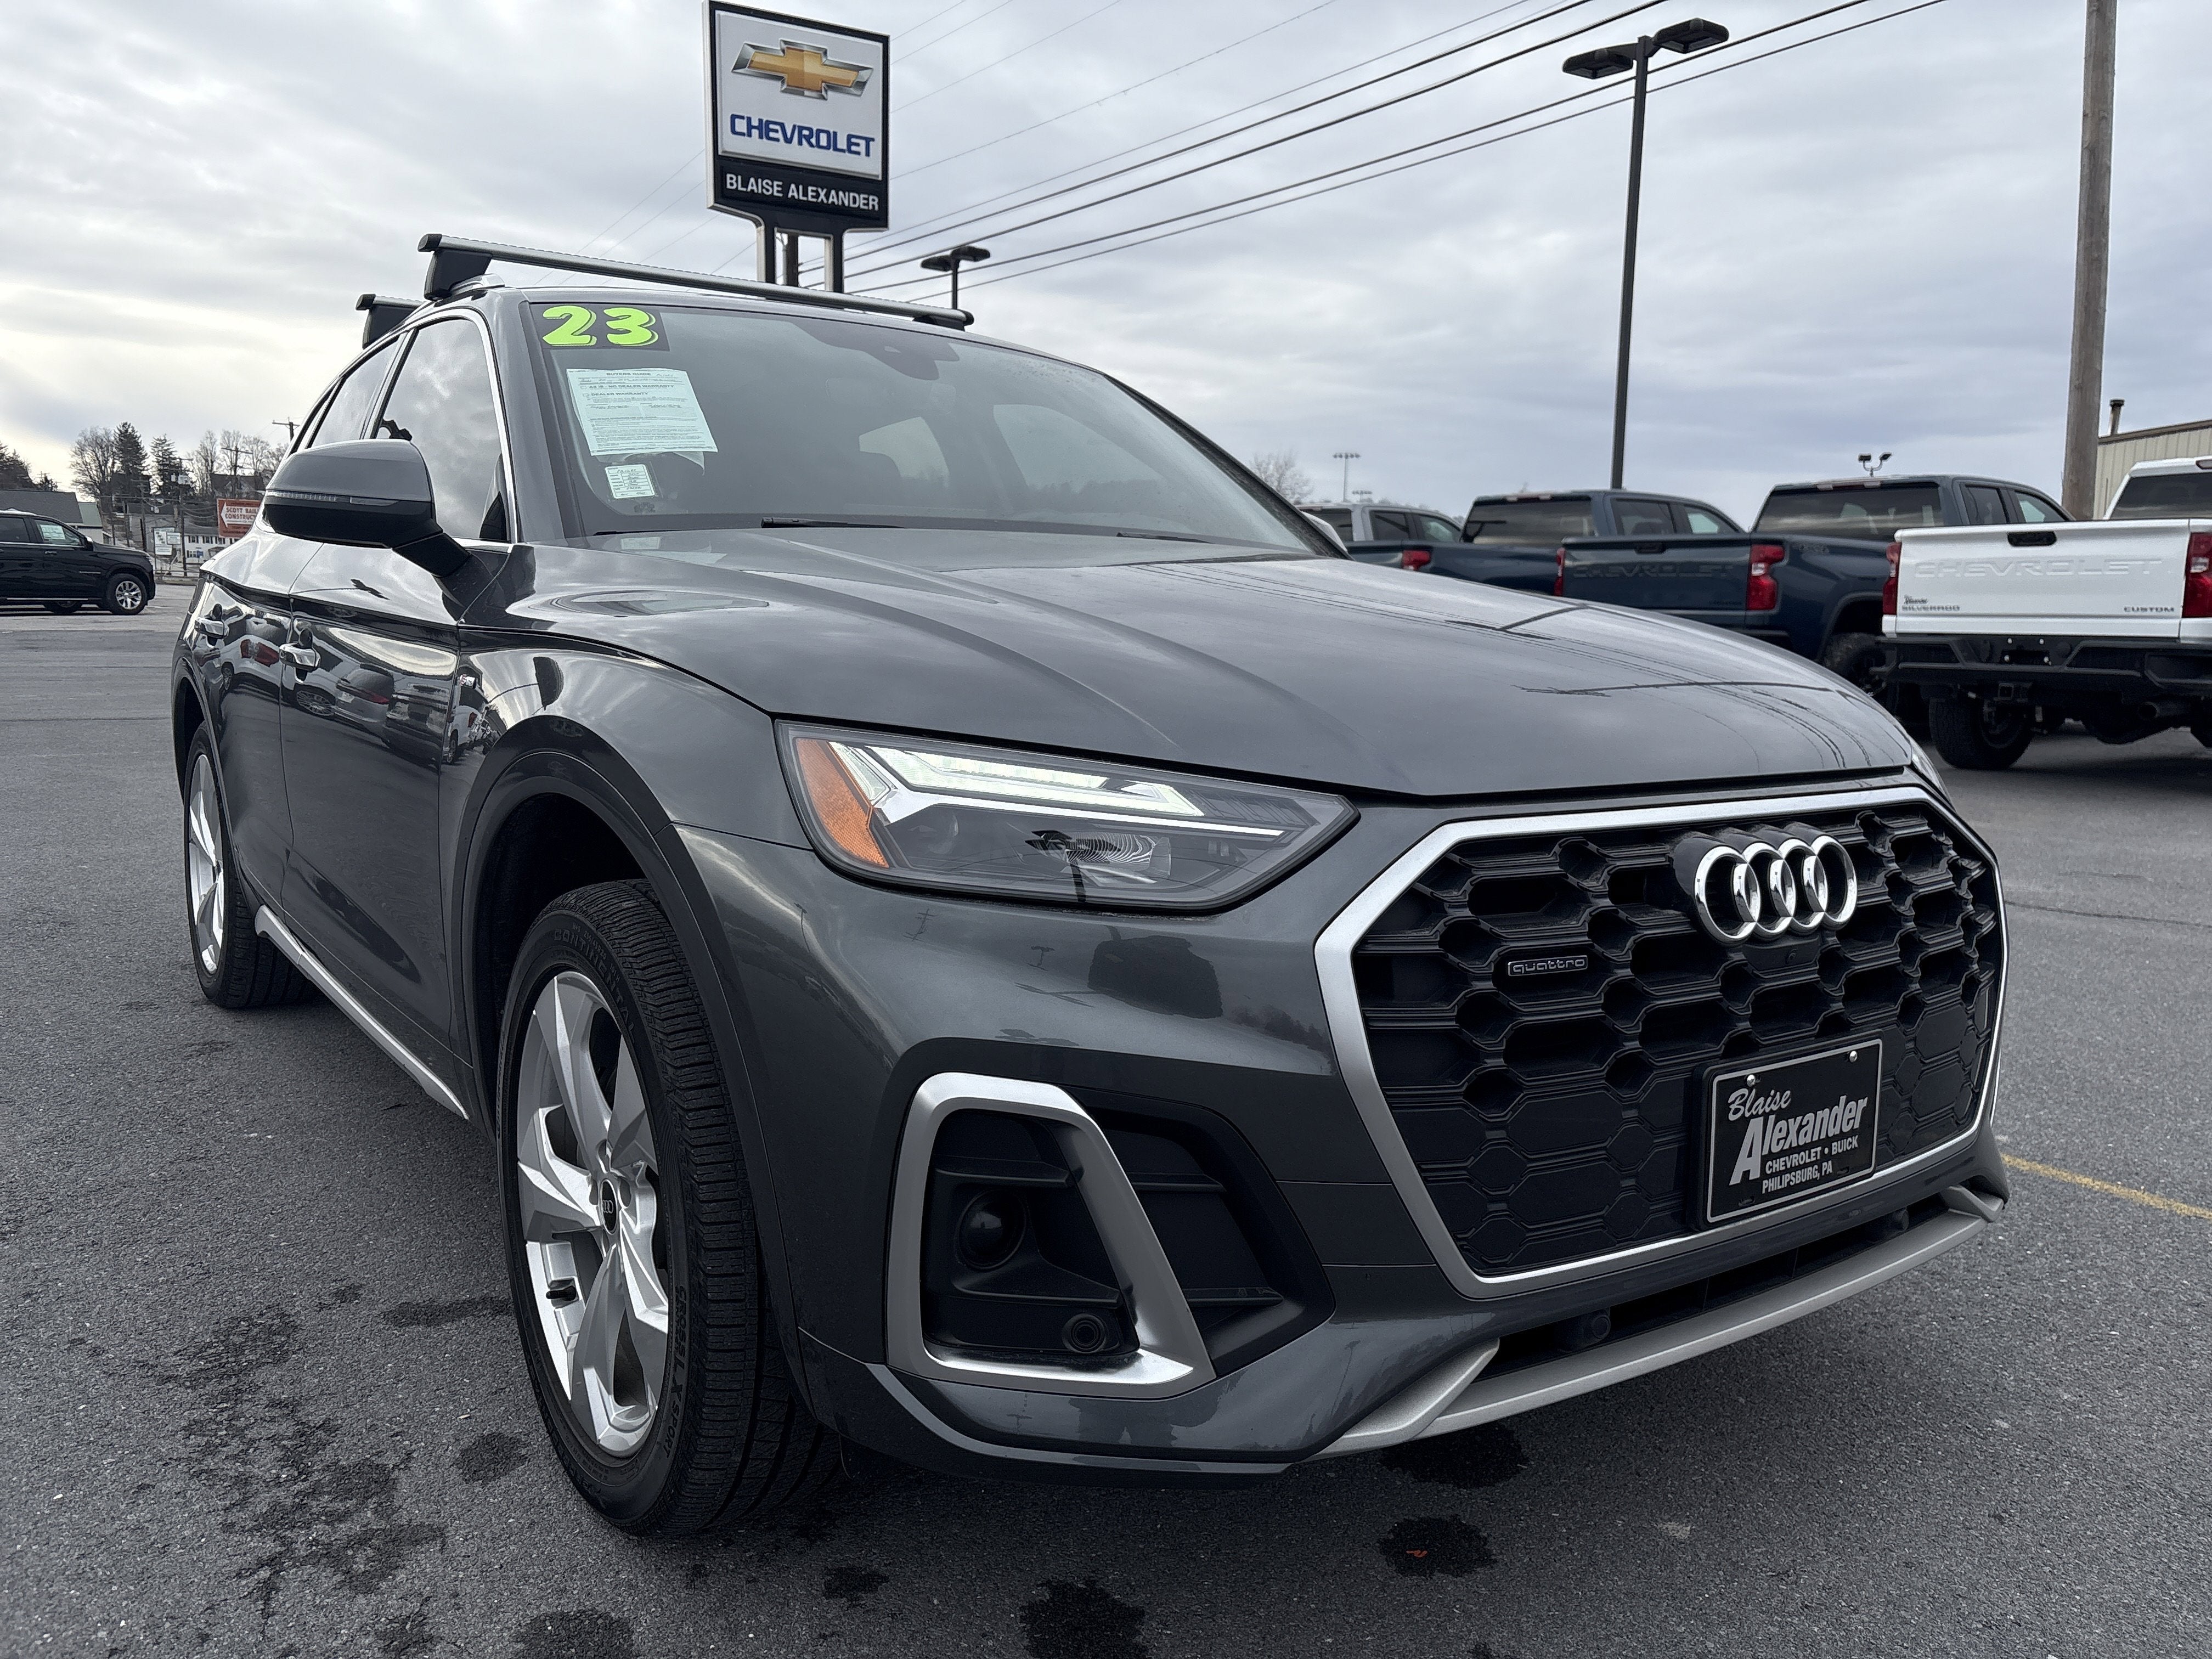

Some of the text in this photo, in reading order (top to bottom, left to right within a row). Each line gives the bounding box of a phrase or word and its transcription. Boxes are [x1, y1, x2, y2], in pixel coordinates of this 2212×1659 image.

[730, 114, 874, 157] CHEVROLET
[726, 173, 879, 211] BLAISE ALEXANDER
[543, 305, 658, 347] 23
[1915, 558, 2162, 578] CHEVROLET
[554, 928, 635, 1045] CONTINENTAL
[1513, 959, 1585, 974] quattro
[1728, 1088, 1791, 1121] Blaise
[1729, 1095, 1868, 1186] Alexander
[1765, 1135, 1859, 1175] CHEVROLET BUICK
[1762, 1160, 1833, 1194] PHILIPSBURG, PA
[663, 1403, 680, 1459] SPORT
